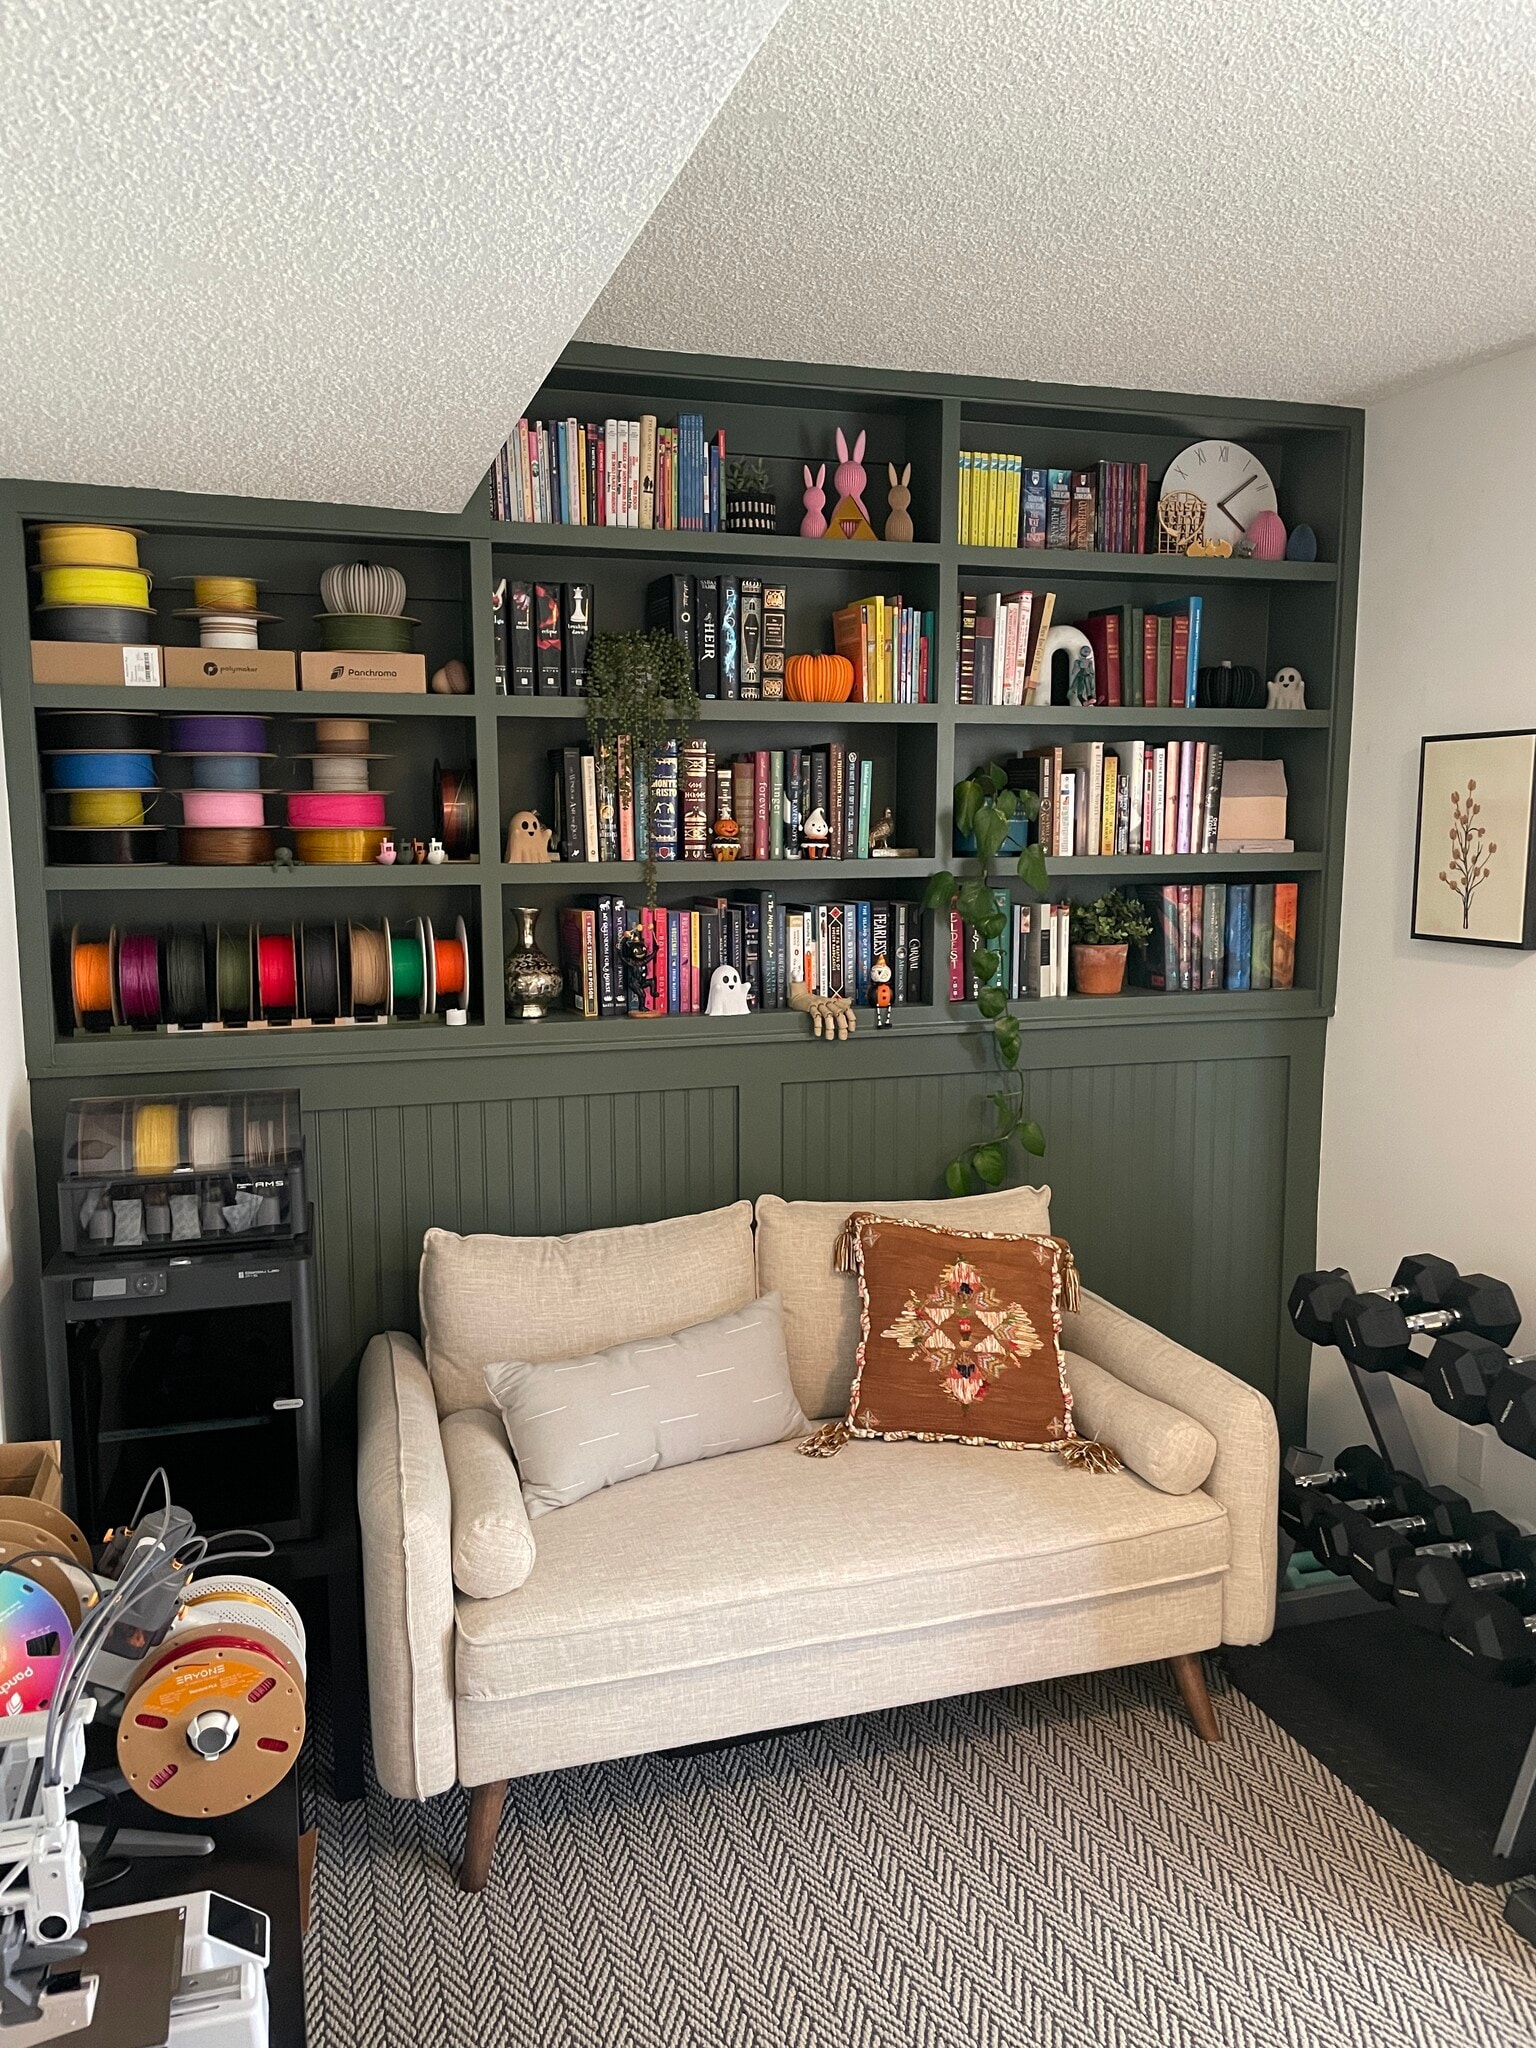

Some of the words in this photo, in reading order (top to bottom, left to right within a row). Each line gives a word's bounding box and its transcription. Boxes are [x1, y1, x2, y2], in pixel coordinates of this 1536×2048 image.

[1158, 501, 1207, 513] KANSAS
[1049, 506, 1060, 544] RADIANCE
[1077, 500, 1088, 549] OATHBRINGER
[702, 621, 717, 661] HEIR
[219, 665, 259, 675] polymaker
[347, 667, 398, 677] Panchroma
[651, 779, 678, 788] MONTE
[759, 782, 769, 820] forever
[771, 783, 783, 815] linger
[791, 799, 800, 823] RAVEN
[791, 824, 800, 843] BOYS
[767, 900, 775, 912] The
[766, 913, 774, 948] Nightingale
[873, 913, 887, 956] FEARLESS
[949, 911, 959, 970] ELDEST
[254, 1180, 284, 1189] AMS
